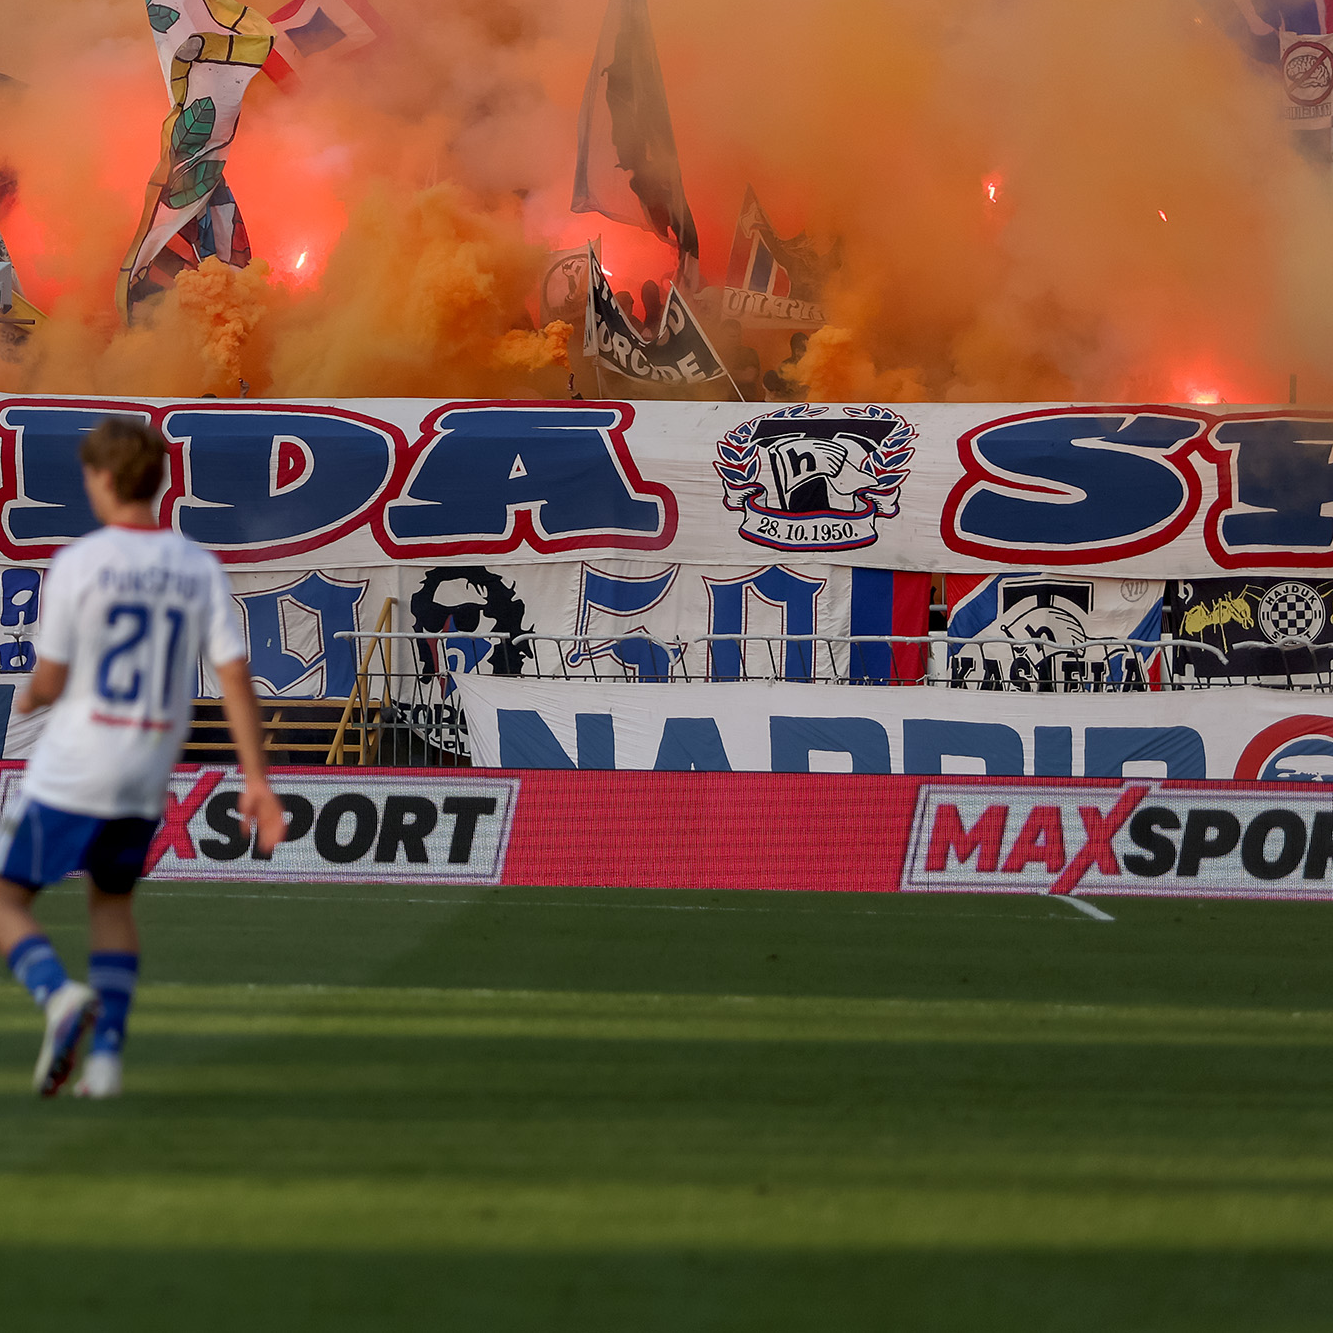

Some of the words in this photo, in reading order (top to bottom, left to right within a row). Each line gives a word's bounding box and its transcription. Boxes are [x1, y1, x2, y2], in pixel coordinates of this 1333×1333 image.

[1265, 585, 1317, 606] HAJDUK
[97, 601, 187, 710] 21
[141, 772, 497, 877] XSPORT
